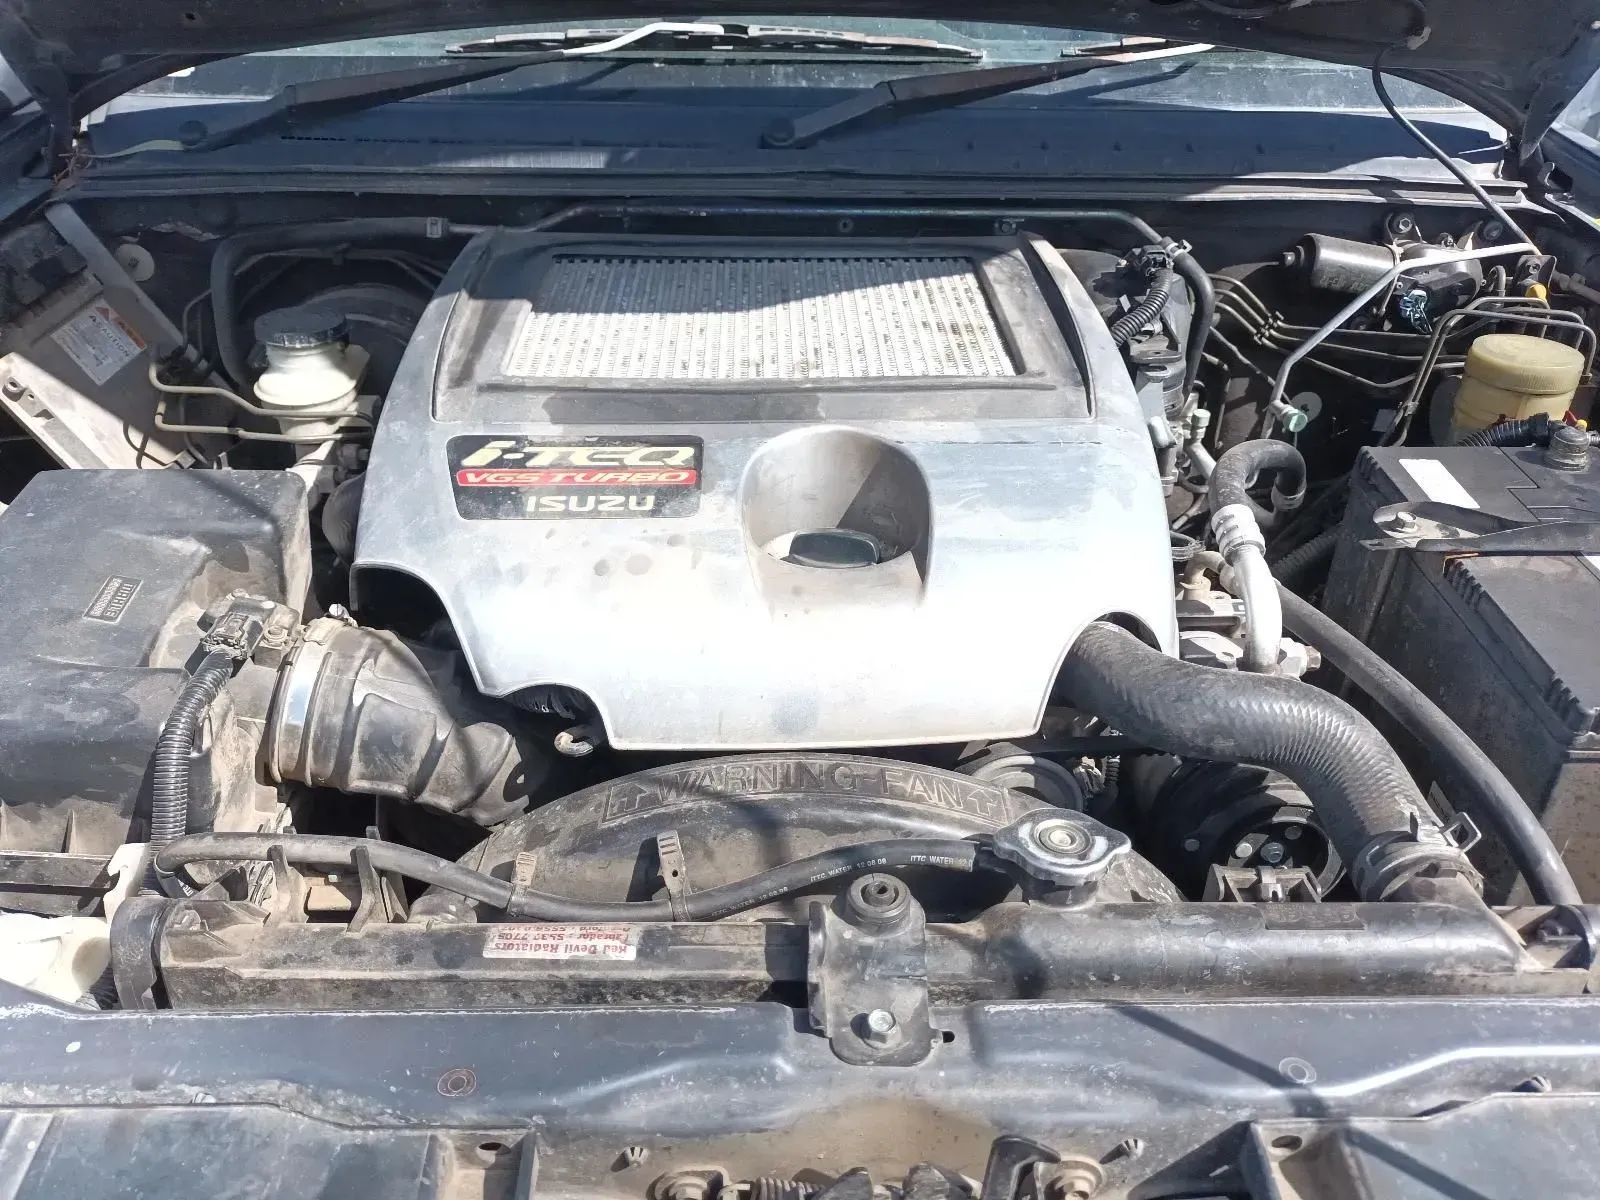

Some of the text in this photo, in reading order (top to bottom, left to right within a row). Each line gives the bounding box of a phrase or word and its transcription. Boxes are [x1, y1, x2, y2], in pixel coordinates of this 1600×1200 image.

[465, 471, 690, 484] VGS TURBO
[527, 495, 656, 512] ISUZU
[929, 855, 954, 865] WATER
[828, 864, 853, 876] WATER
[494, 942, 560, 954] Radiators
[564, 944, 597, 955] Devil
